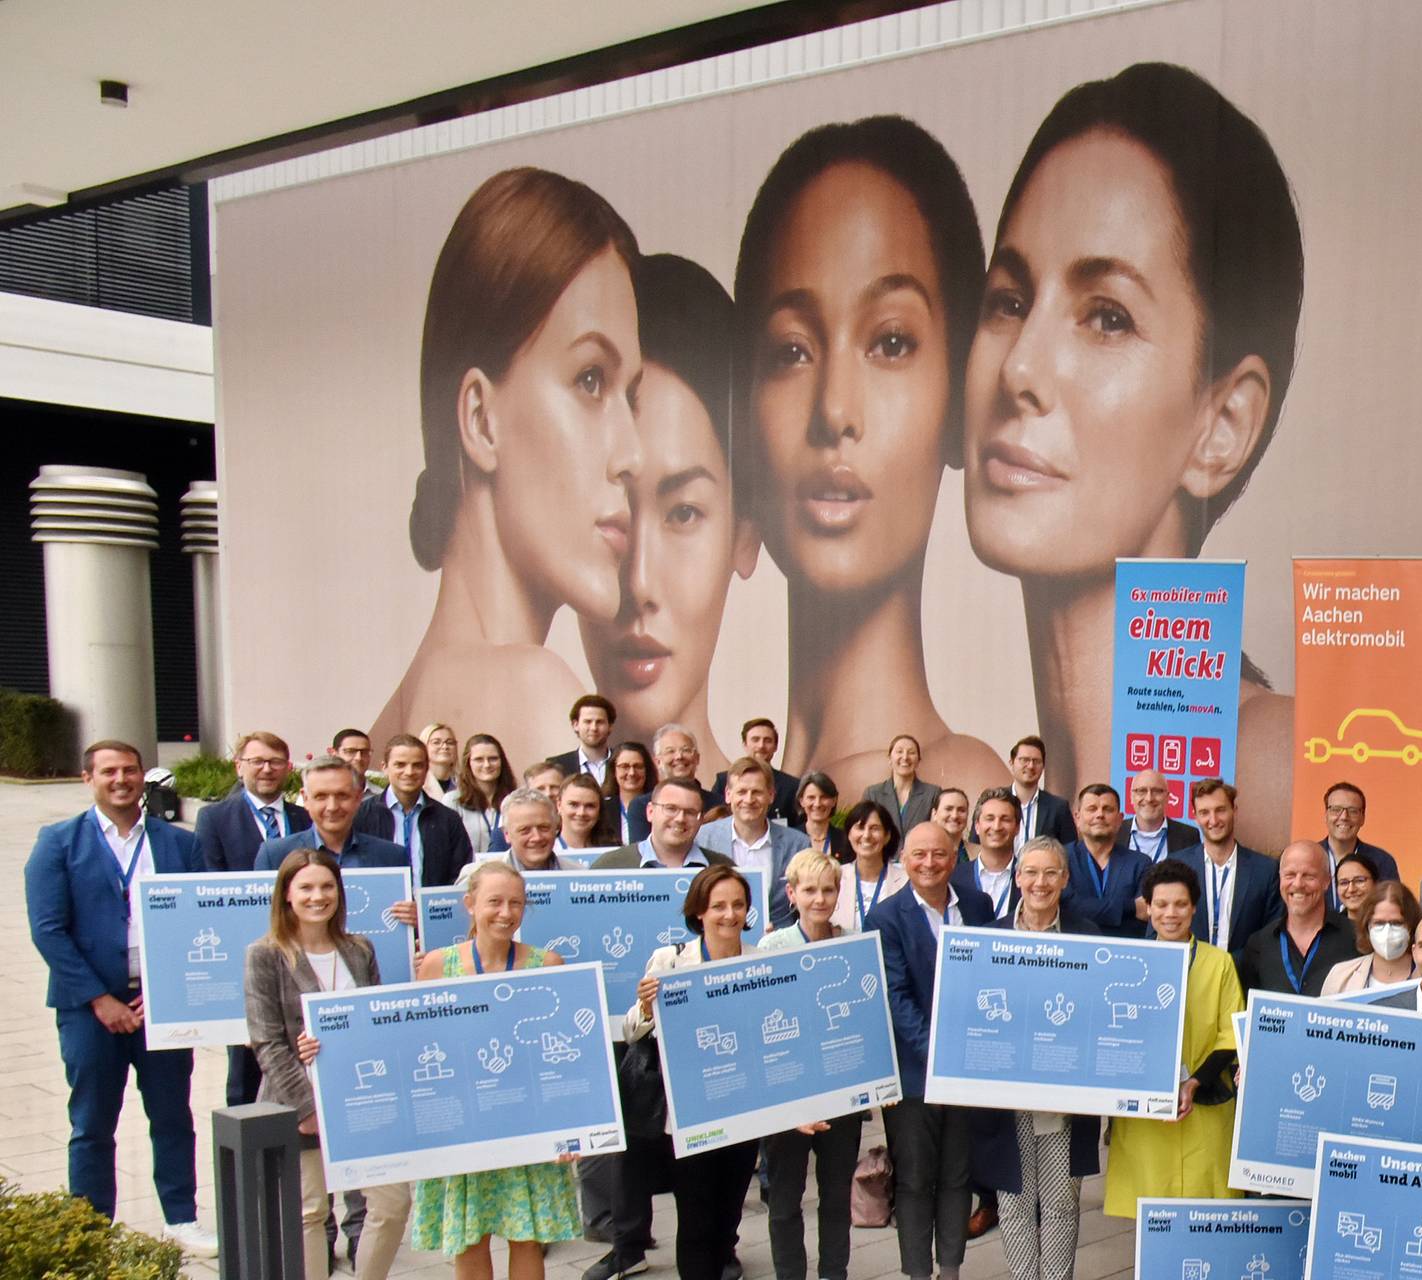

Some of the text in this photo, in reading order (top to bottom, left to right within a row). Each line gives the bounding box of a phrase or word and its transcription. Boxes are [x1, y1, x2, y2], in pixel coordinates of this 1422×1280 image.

[1131, 587, 1229, 604] 6x mobiler mit
[1303, 583, 1400, 601] Wir machen
[1302, 606, 1363, 623] Aachen
[1129, 608, 1211, 640] einem
[1302, 628, 1405, 647] elektromobil
[1147, 647, 1226, 680] Klick!
[1128, 687, 1184, 699] Route suchen,
[1137, 701, 1175, 713] bezahlen,
[196, 885, 242, 896] Unsere
[570, 880, 644, 893] Unsere Ziele
[198, 895, 272, 908] und Ambiti
[571, 892, 670, 904] und Ambitionen
[950, 938, 980, 948] Aachen
[992, 941, 1064, 957] Unsere Ziele
[949, 953, 973, 962] mobil
[991, 954, 1088, 971] und Ambitionen
[704, 963, 773, 986] Unsere Ziele
[663, 979, 692, 991] Aachen
[706, 974, 798, 999] und Ambitionen
[369, 991, 458, 1013] Unsere Ziele
[318, 1003, 355, 1015] Aachen
[372, 1002, 490, 1026] und Ambitionen
[1260, 1006, 1294, 1018] Aachen
[1259, 1014, 1286, 1025] clever
[1307, 1012, 1389, 1034] Unsere Ziele
[320, 1021, 350, 1032] mobil
[1258, 1023, 1285, 1034] mobil
[1306, 1027, 1416, 1051] und Ambitionen
[1330, 1150, 1366, 1163] Aachen
[1330, 1159, 1358, 1172] clever
[1329, 1168, 1357, 1180] mobil
[1379, 1173, 1408, 1188] und
[1148, 1209, 1177, 1218] Aachen
[1189, 1210, 1259, 1222] Unsere Ziele
[1189, 1223, 1283, 1235] und Ambitionen
